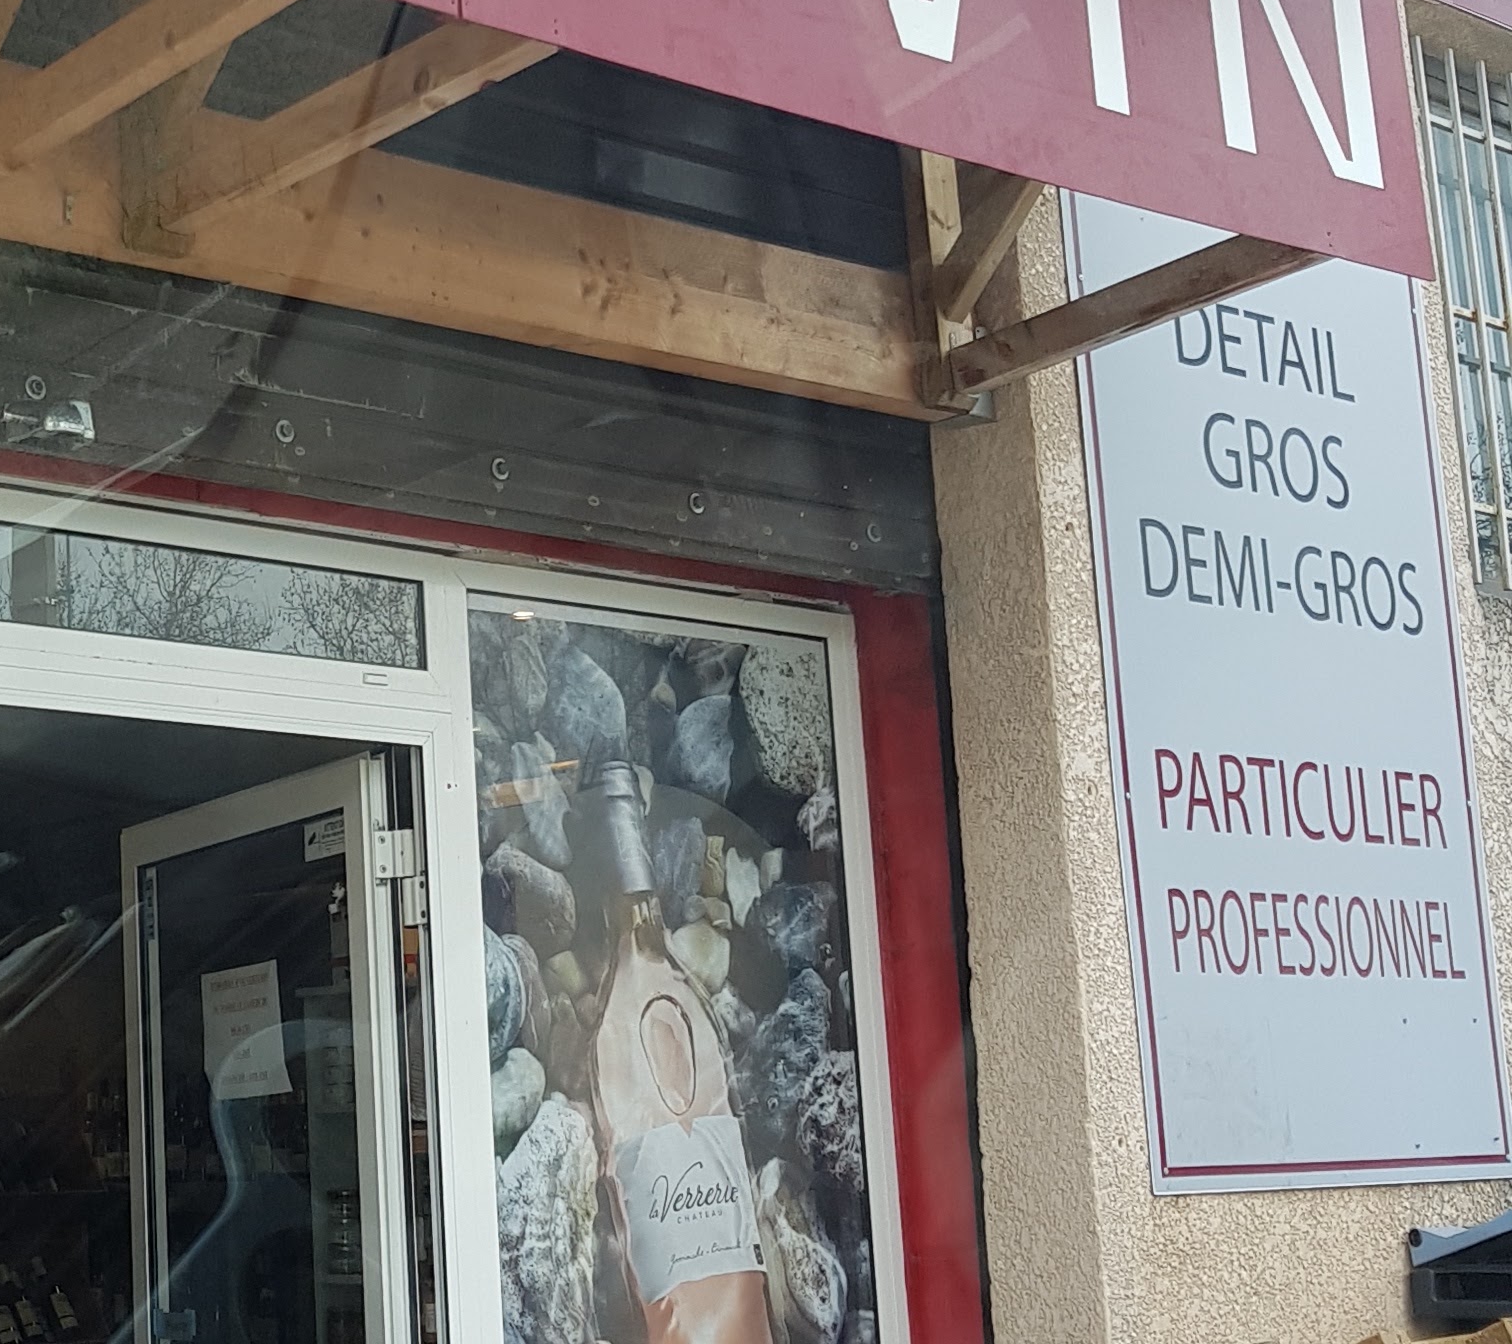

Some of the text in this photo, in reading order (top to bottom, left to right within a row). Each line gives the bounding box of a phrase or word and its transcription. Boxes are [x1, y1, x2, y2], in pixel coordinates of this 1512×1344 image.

[1175, 304, 1355, 402] DETAIL
[1202, 411, 1351, 510] GROS
[1138, 518, 1424, 636] DEMI-GROS
[1154, 747, 1448, 850] PARTICULIER
[1166, 887, 1467, 980] PROFESSIONNEL
